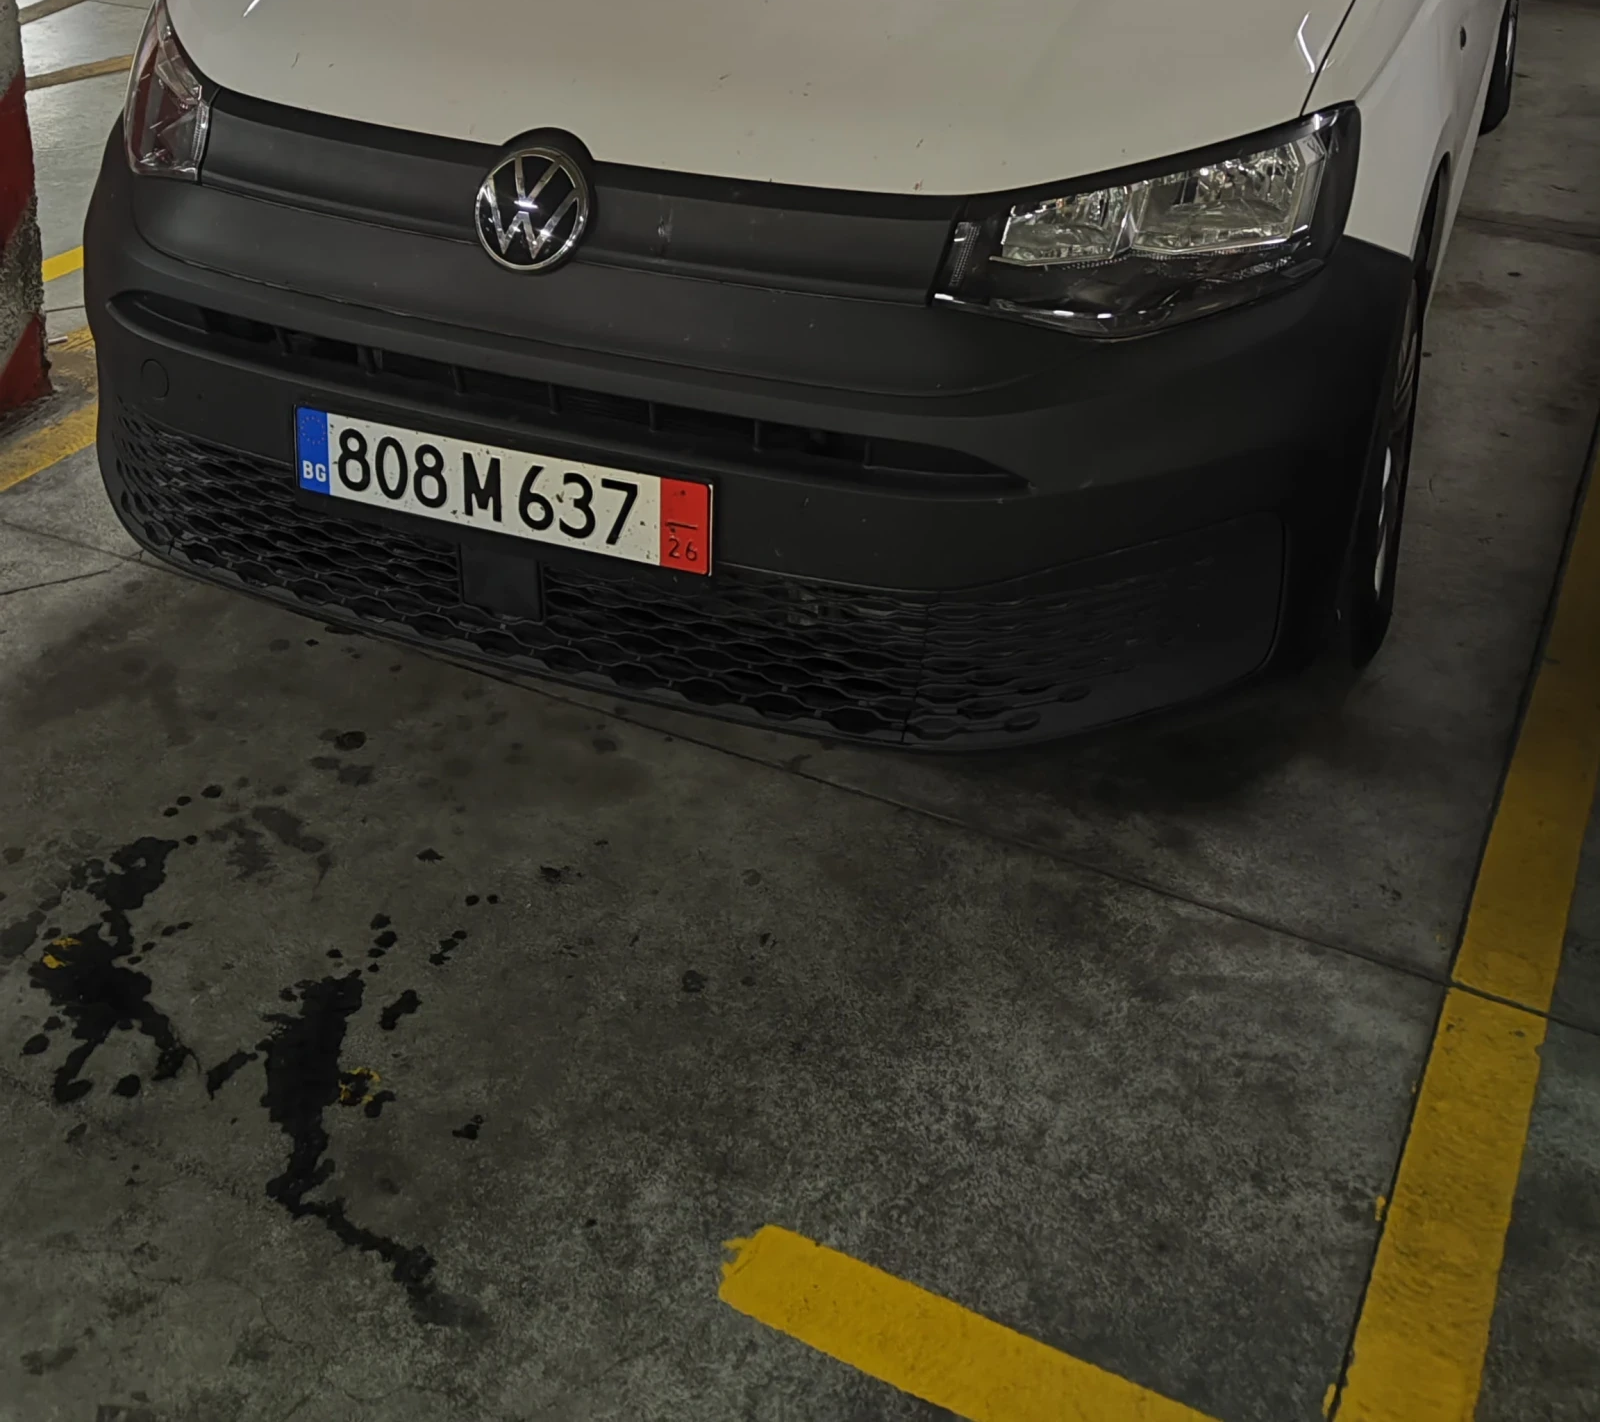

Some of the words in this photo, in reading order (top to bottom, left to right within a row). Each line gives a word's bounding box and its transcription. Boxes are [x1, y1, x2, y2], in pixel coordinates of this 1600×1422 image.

[480, 151, 585, 265] VW
[302, 460, 327, 483] BG
[668, 536, 698, 562] 26
